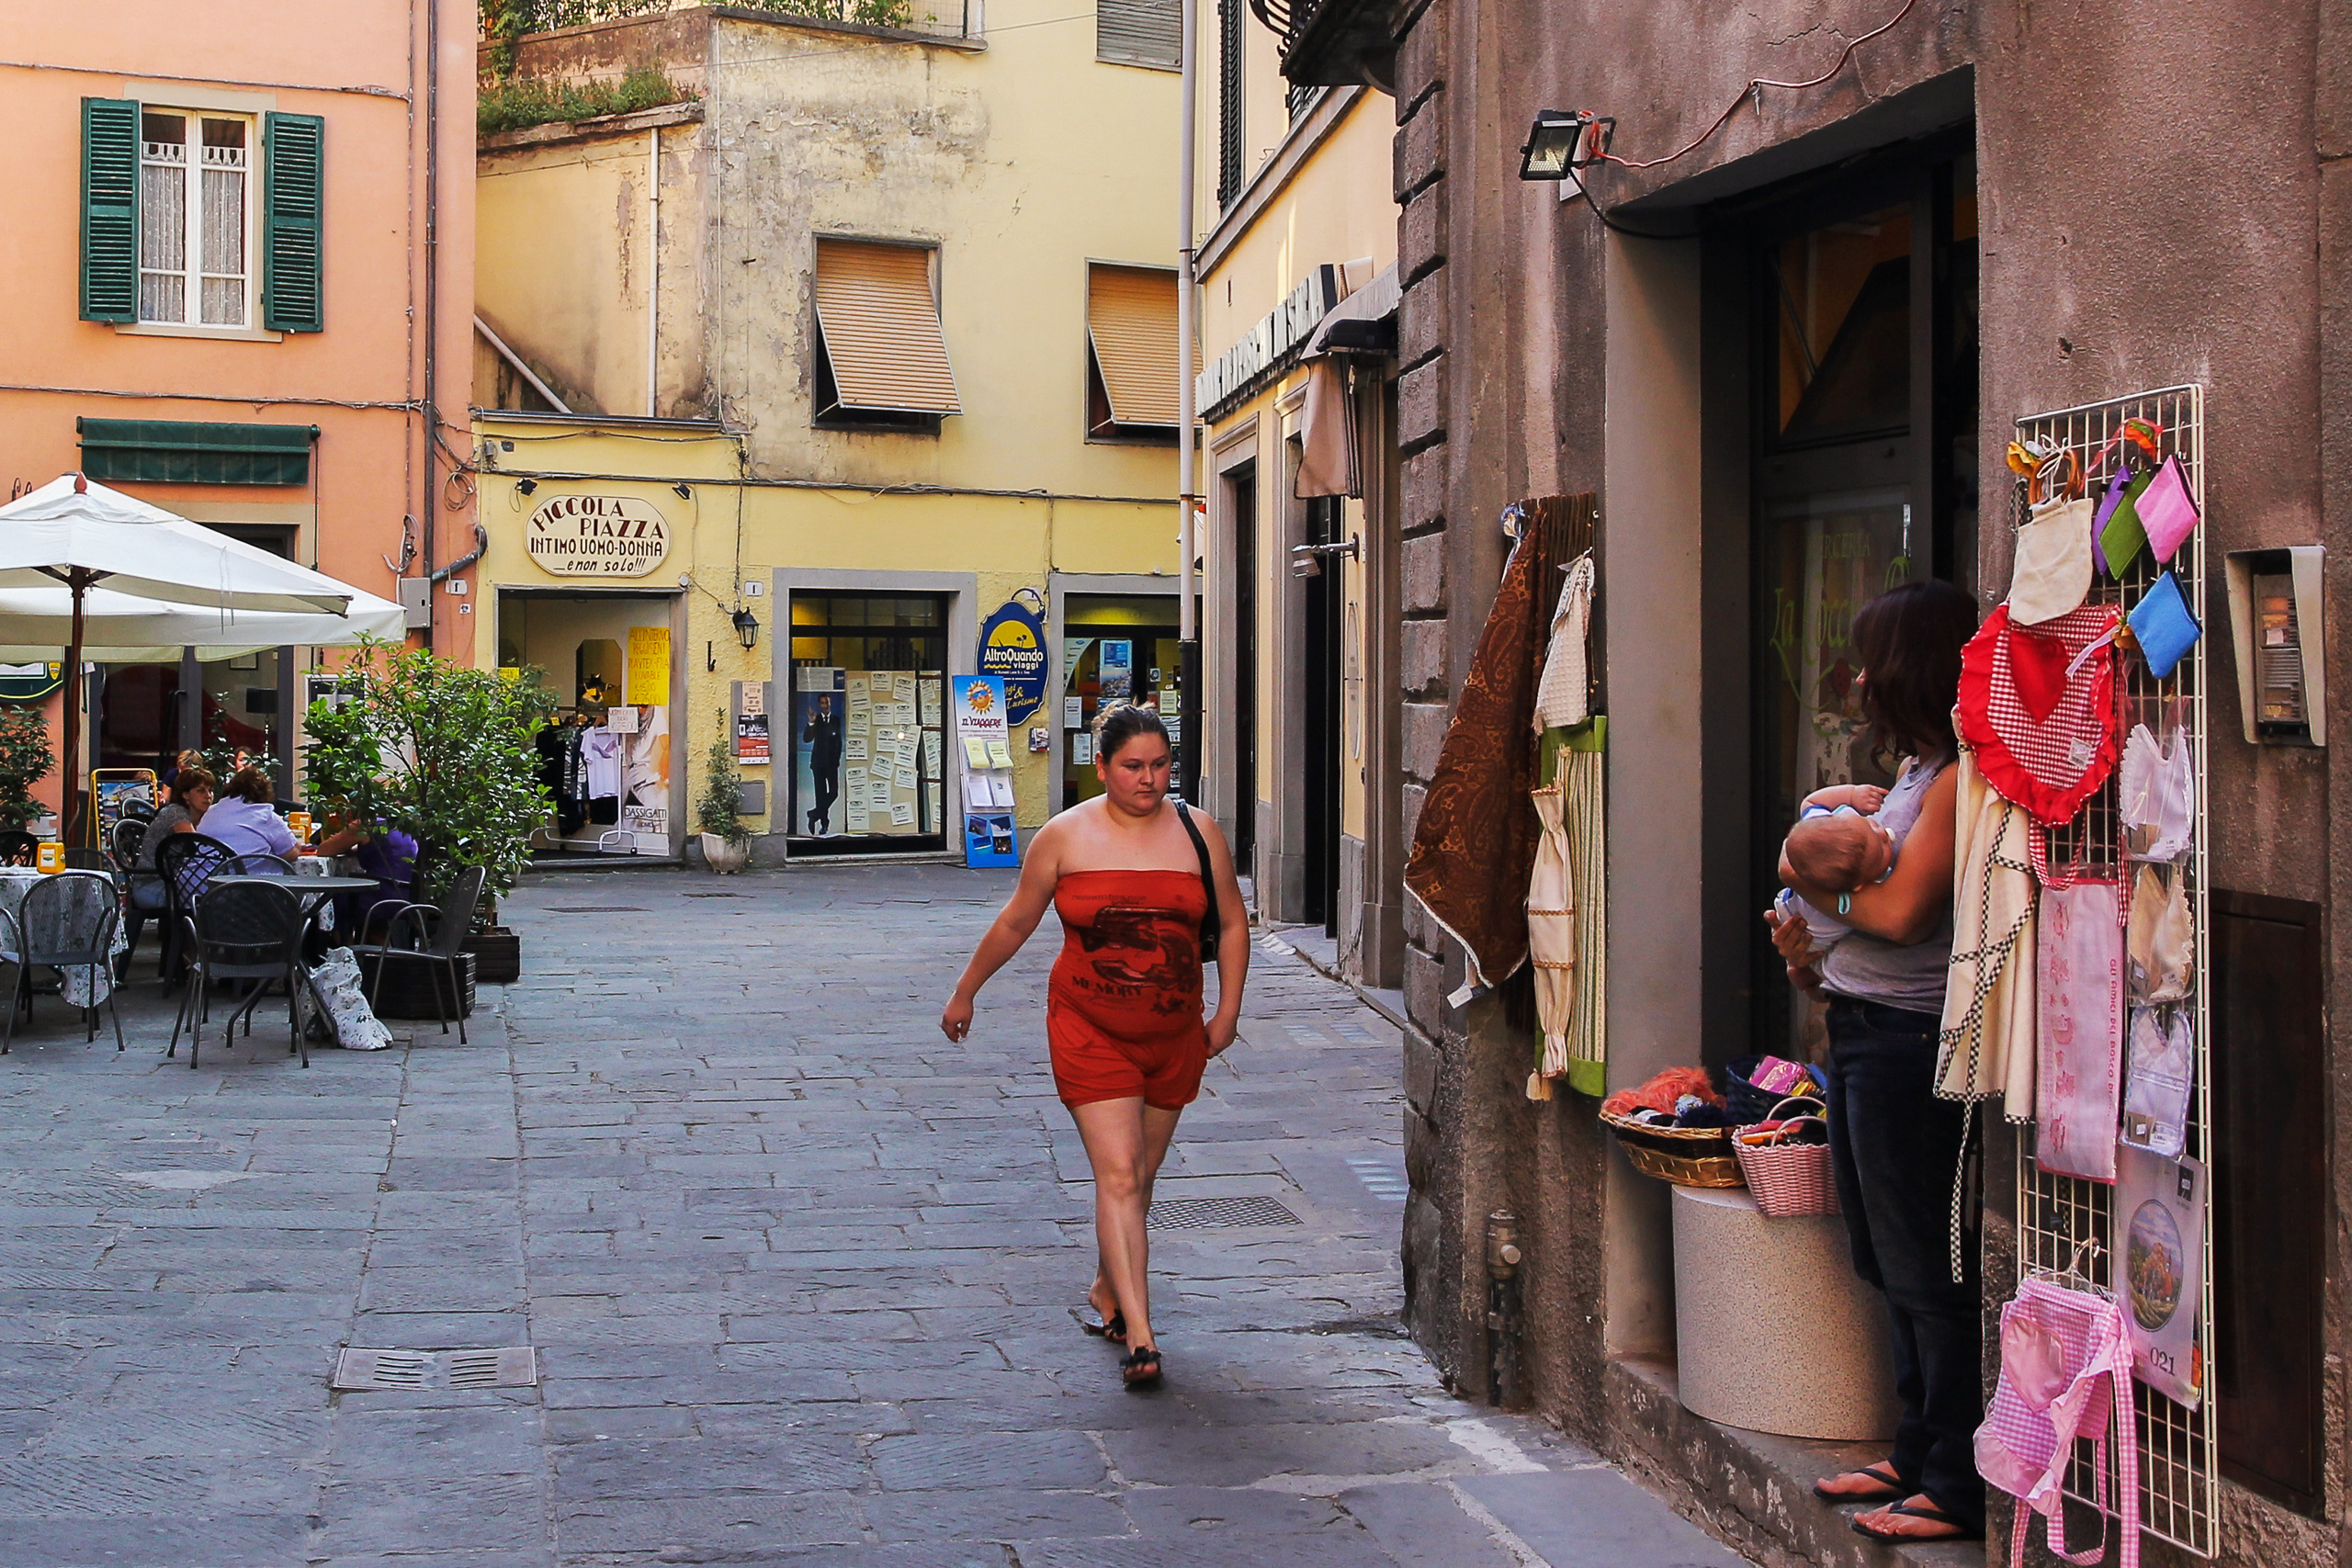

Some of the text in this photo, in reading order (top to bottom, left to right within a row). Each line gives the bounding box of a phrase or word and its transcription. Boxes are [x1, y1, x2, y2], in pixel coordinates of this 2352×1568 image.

[532, 496, 625, 533] PICCOLA
[580, 517, 664, 540] PIAZZA
[530, 536, 662, 557] INTIMO UOMO-DONNA
[574, 559, 597, 571] non
[604, 557, 647, 572] solo!!!
[984, 648, 1044, 664] AltroQuando
[1013, 661, 1039, 670] viaggi
[1013, 686, 1023, 699] &
[2150, 1347, 2176, 1377] 021
